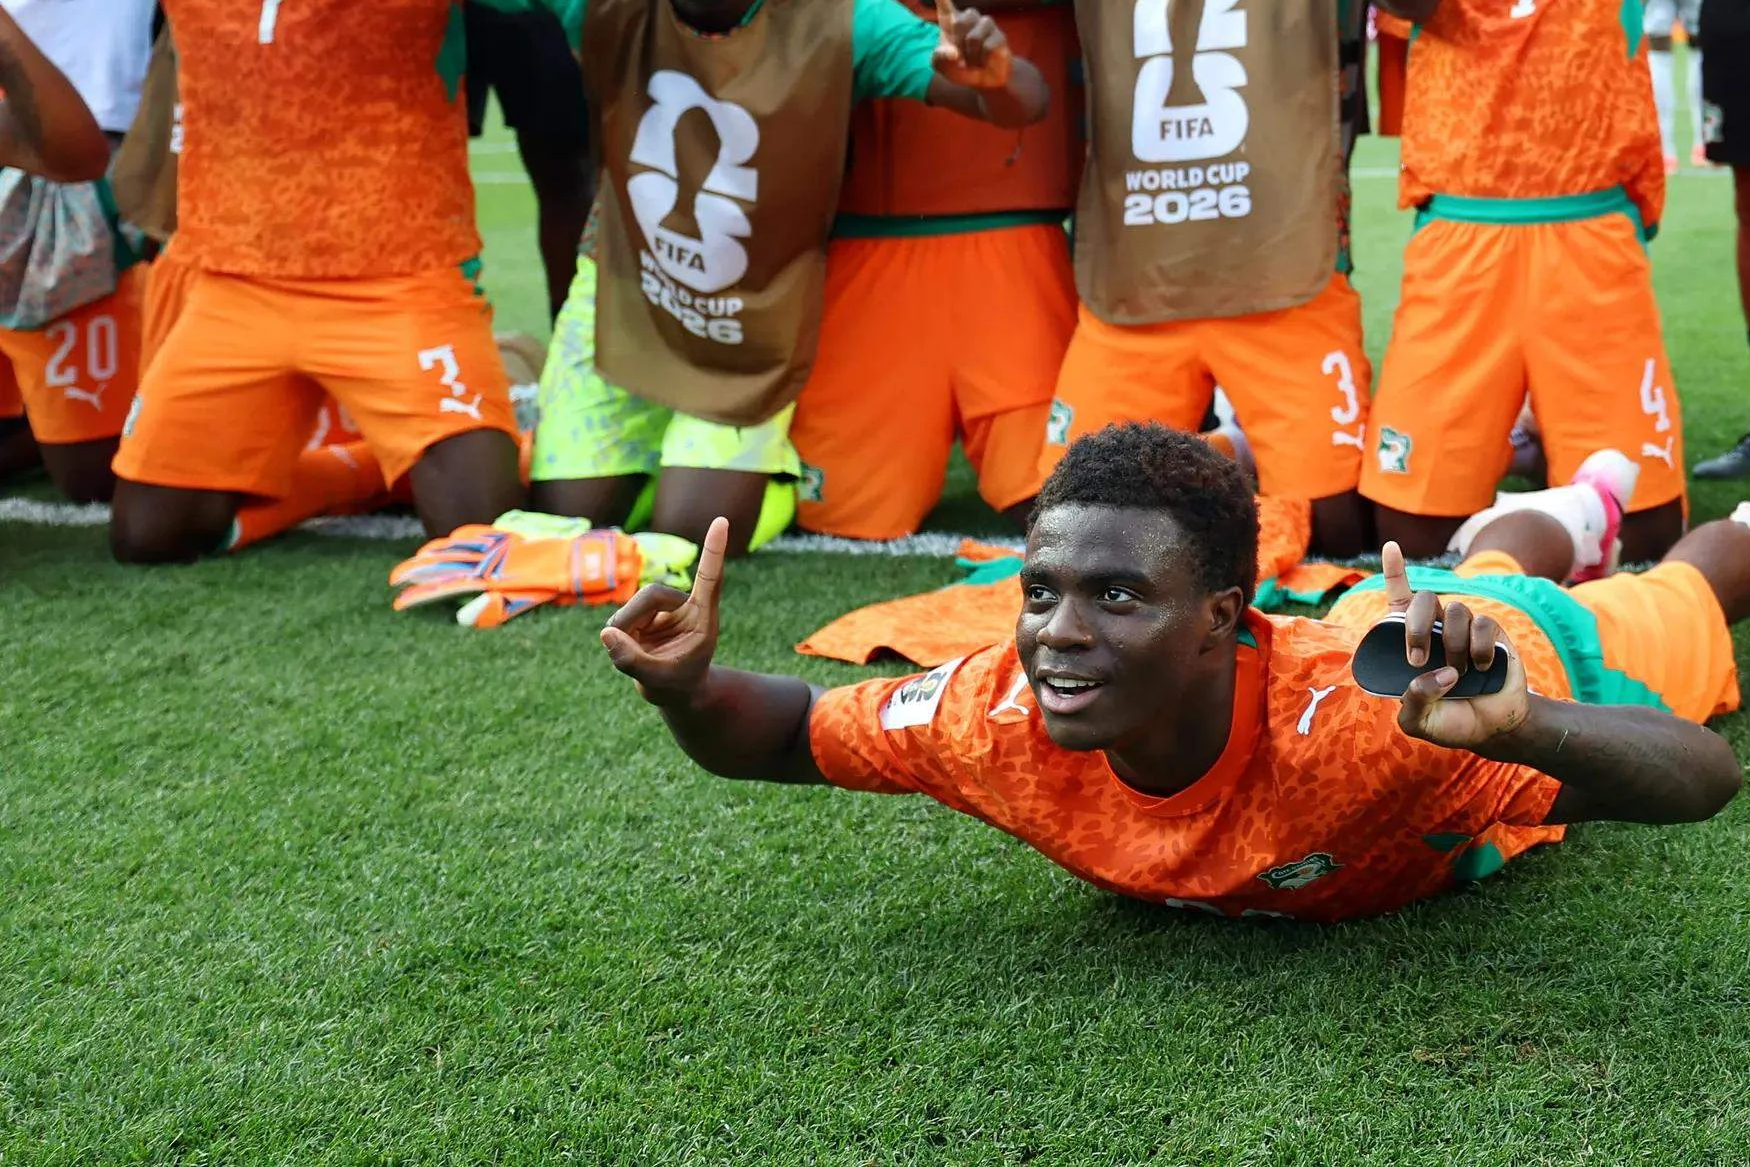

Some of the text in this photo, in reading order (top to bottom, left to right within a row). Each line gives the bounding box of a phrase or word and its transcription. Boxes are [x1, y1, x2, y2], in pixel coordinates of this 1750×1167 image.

[1160, 117, 1214, 142] FIFA
[1125, 161, 1250, 191] WORLD CUP
[1124, 185, 1252, 226] 2026
[654, 237, 707, 273] FIFA
[694, 297, 744, 317] CUP
[45, 316, 118, 386] 20
[417, 343, 466, 398] 7
[1322, 349, 1359, 426] 3
[1640, 358, 1671, 432] 4
